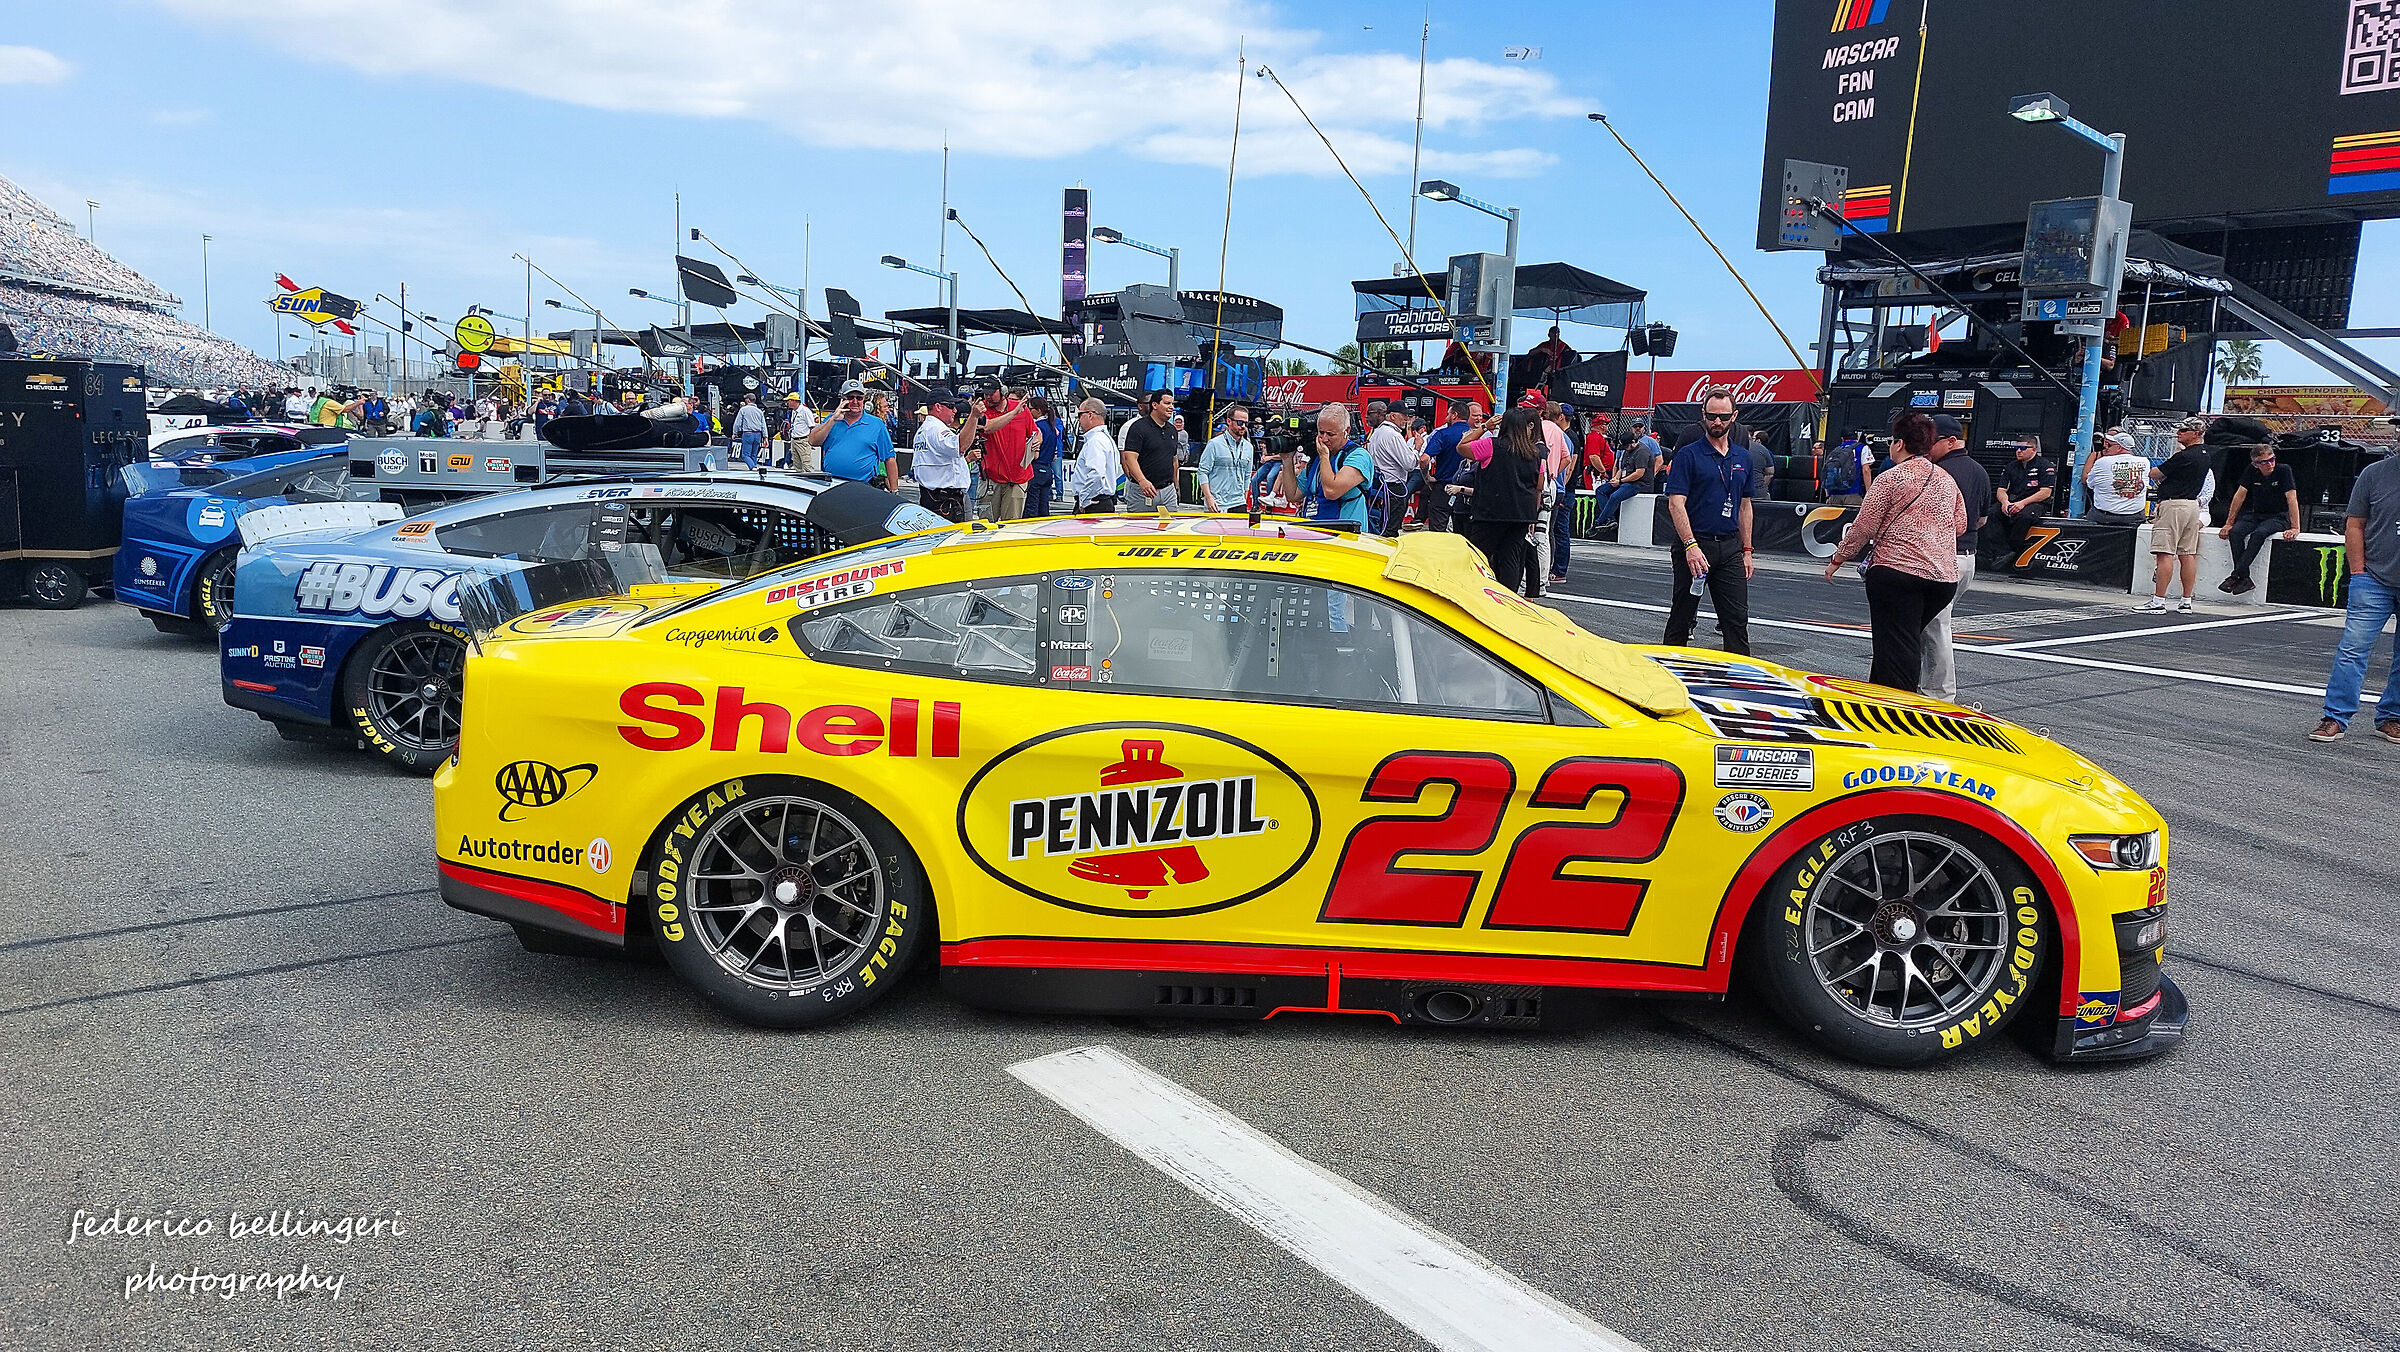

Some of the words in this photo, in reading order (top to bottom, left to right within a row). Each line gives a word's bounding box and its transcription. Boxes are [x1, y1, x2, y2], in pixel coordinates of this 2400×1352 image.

[1822, 36, 1900, 69] NASCAR
[1838, 70, 1874, 95] FAN
[1832, 97, 1875, 123] CAM
[1994, 272, 2021, 283] CELS
[277, 296, 323, 313] SUN
[1082, 296, 1115, 307] TRACKHO
[1181, 291, 1258, 308] TRACKHOUSE
[1384, 310, 1446, 325] mahind
[1388, 322, 1450, 335] TRACTORS
[457, 354, 480, 368] 50
[84, 373, 104, 396] 84
[1570, 381, 1608, 392] mahindra
[2319, 430, 2341, 442] 33
[377, 456, 408, 467] BUSCH
[424, 459, 431, 472] 1
[450, 457, 471, 466] GW
[689, 526, 726, 547] BUSCH
[1117, 547, 1188, 558] JOEY
[1193, 548, 1299, 563] LOGANO
[2014, 526, 2061, 567] 7
[2035, 552, 2067, 563] Corey
[2046, 561, 2079, 571] LaJoie
[766, 560, 905, 604] DISCOUNT
[1059, 577, 1089, 589] Ford
[200, 577, 217, 617] EAGLE
[296, 561, 463, 623] #BUSC
[803, 584, 866, 605] TIRE
[1060, 607, 1086, 623] PPG
[665, 626, 757, 649] Capgemini
[1050, 639, 1093, 650] Mazak
[263, 654, 296, 664] PRISTINE
[263, 661, 296, 669] AUCTION
[1051, 666, 1089, 680] Coca-Cola
[617, 682, 961, 758] Shell
[353, 707, 396, 754] EAGLE
[1746, 750, 1799, 763] NASCAR
[1728, 766, 1753, 779] CUP
[1754, 767, 1800, 781] SERIES
[1842, 763, 1997, 801] GOODYEAR
[502, 762, 563, 807] AAA
[1721, 793, 1749, 806] NASCAR
[1009, 775, 1269, 861] PENNZOIL
[1720, 817, 1767, 832] ANNIVERSARY
[458, 834, 584, 866] Autotrader
[1316, 749, 1687, 937] 22
[656, 778, 747, 942] GOODYEAR
[1784, 837, 1838, 926] EAGLE
[2147, 866, 2166, 908] 22
[858, 899, 909, 988] EAGLE
[1938, 886, 2039, 1049] GOODYEAR
[2076, 1003, 2118, 1017] SUNOCO
